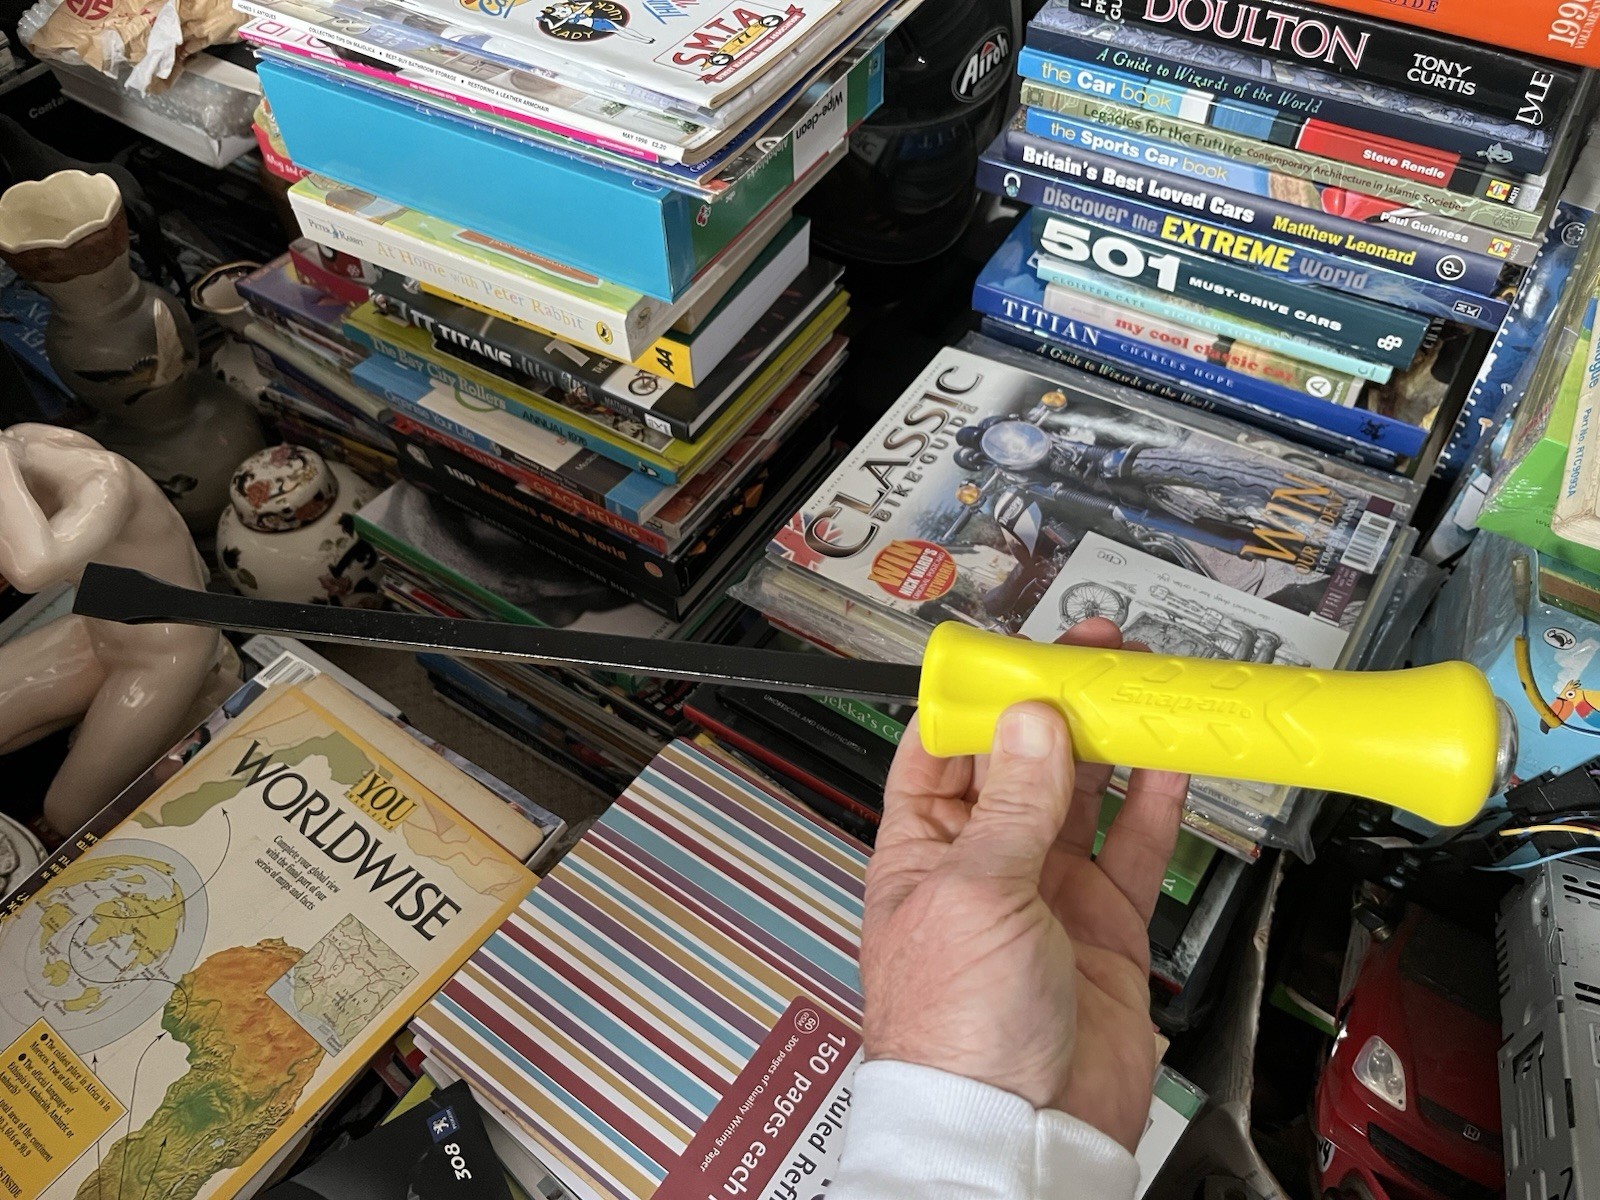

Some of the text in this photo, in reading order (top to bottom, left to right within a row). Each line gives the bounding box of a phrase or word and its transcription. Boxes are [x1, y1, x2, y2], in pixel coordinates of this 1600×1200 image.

[551, 25, 594, 40] LADY
[1143, 0, 1370, 69] DOULTON
[1547, 0, 1592, 47] 199
[407, 59, 435, 75] BATHROOM
[434, 68, 457, 82] STORAGE
[467, 81, 492, 95] RESTORING
[499, 91, 523, 105] LEATHER
[522, 98, 550, 113] ARMCHAIR
[960, 34, 1009, 95] Airoh
[1041, 62, 1173, 111] the Car book
[1097, 47, 1322, 115] A Guide to Wizards of the World
[1406, 69, 1477, 96] CURTIS
[1412, 53, 1472, 78] TONY
[795, 91, 845, 140] Wipe-clean
[1515, 70, 1555, 127] LYLE
[621, 131, 635, 141] MAY
[1050, 122, 1229, 182] the Sports Car book
[1083, 103, 1467, 213] Legacies for the Future Contemporary Architecture in Islamic Societies
[1362, 149, 1446, 179] Steve Rendle
[1022, 145, 1418, 267] Britain's Best Loved Cars Matthew Leonard
[1379, 211, 1469, 244] Paul Guinness
[1040, 217, 1181, 293] 501
[1042, 185, 1370, 289] Discover the EXTREME World
[376, 241, 396, 259] At
[399, 248, 446, 279] Home
[450, 267, 479, 292] with
[482, 279, 525, 308] Peter
[531, 299, 586, 331] Rabbit
[1051, 276, 1111, 299] CLOISTER
[1115, 292, 1146, 309] CATS
[1187, 276, 1343, 332] MUST-DRIVE CARS
[437, 324, 513, 369] TITANS
[654, 346, 676, 374] AA
[1001, 298, 1235, 389] TITIAN CHARLES HOPE
[1114, 317, 1260, 372] my cool classic
[371, 335, 507, 412] The Bay City Rollers
[1035, 344, 1177, 399] A Guide to Wizards of the
[454, 418, 477, 437] Life
[521, 411, 567, 438] ANNUAL
[1578, 425, 1588, 444] No.
[1583, 407, 1592, 425] Part
[446, 463, 477, 487] 100
[804, 365, 984, 558] CLASSIC
[872, 404, 980, 523] BIKE GUIDE
[531, 479, 580, 509] GRACE
[584, 503, 640, 541] HELBIG
[1240, 473, 1330, 562] WIN
[867, 539, 927, 588] WIN
[899, 547, 939, 597] NICK WARD'S
[1294, 546, 1321, 575] OUR
[818, 694, 878, 730] Jekka's
[356, 773, 418, 824] YOU
[230, 740, 462, 941] WORLDWISE
[273, 835, 341, 894] Complete your global view
[255, 858, 273, 874] series
[275, 876, 293, 890] maps
[289, 887, 305, 900] and
[299, 894, 316, 911] facts
[265, 847, 280, 861] with
[276, 857, 288, 868] the
[285, 864, 303, 879] final
[295, 875, 312, 889] part
[314, 891, 327, 902] our
[796, 1012, 810, 1027] GSM
[804, 1017, 816, 1031] 60
[23, 1058, 34, 1071] The
[31, 1069, 50, 1088] official
[45, 1084, 67, 1109] language
[46, 1038, 56, 1051] The
[53, 1049, 72, 1068] coldest
[66, 1065, 82, 1081] place
[85, 1083, 101, 1101] Africa
[48, 1061, 60, 1076] True
[7, 1061, 28, 1085] Ethiopia
[48, 1109, 71, 1133] Amharic
[699, 1035, 800, 1173] 300 pages of Quality Writing Paper
[723, 1032, 846, 1195] 150 pages each
[7, 1110, 21, 1125] area
[23, 1127, 33, 1139] the
[30, 1136, 54, 1163] continent
[444, 1142, 472, 1181] 308
[1, 1173, 23, 1199] INSIDE
